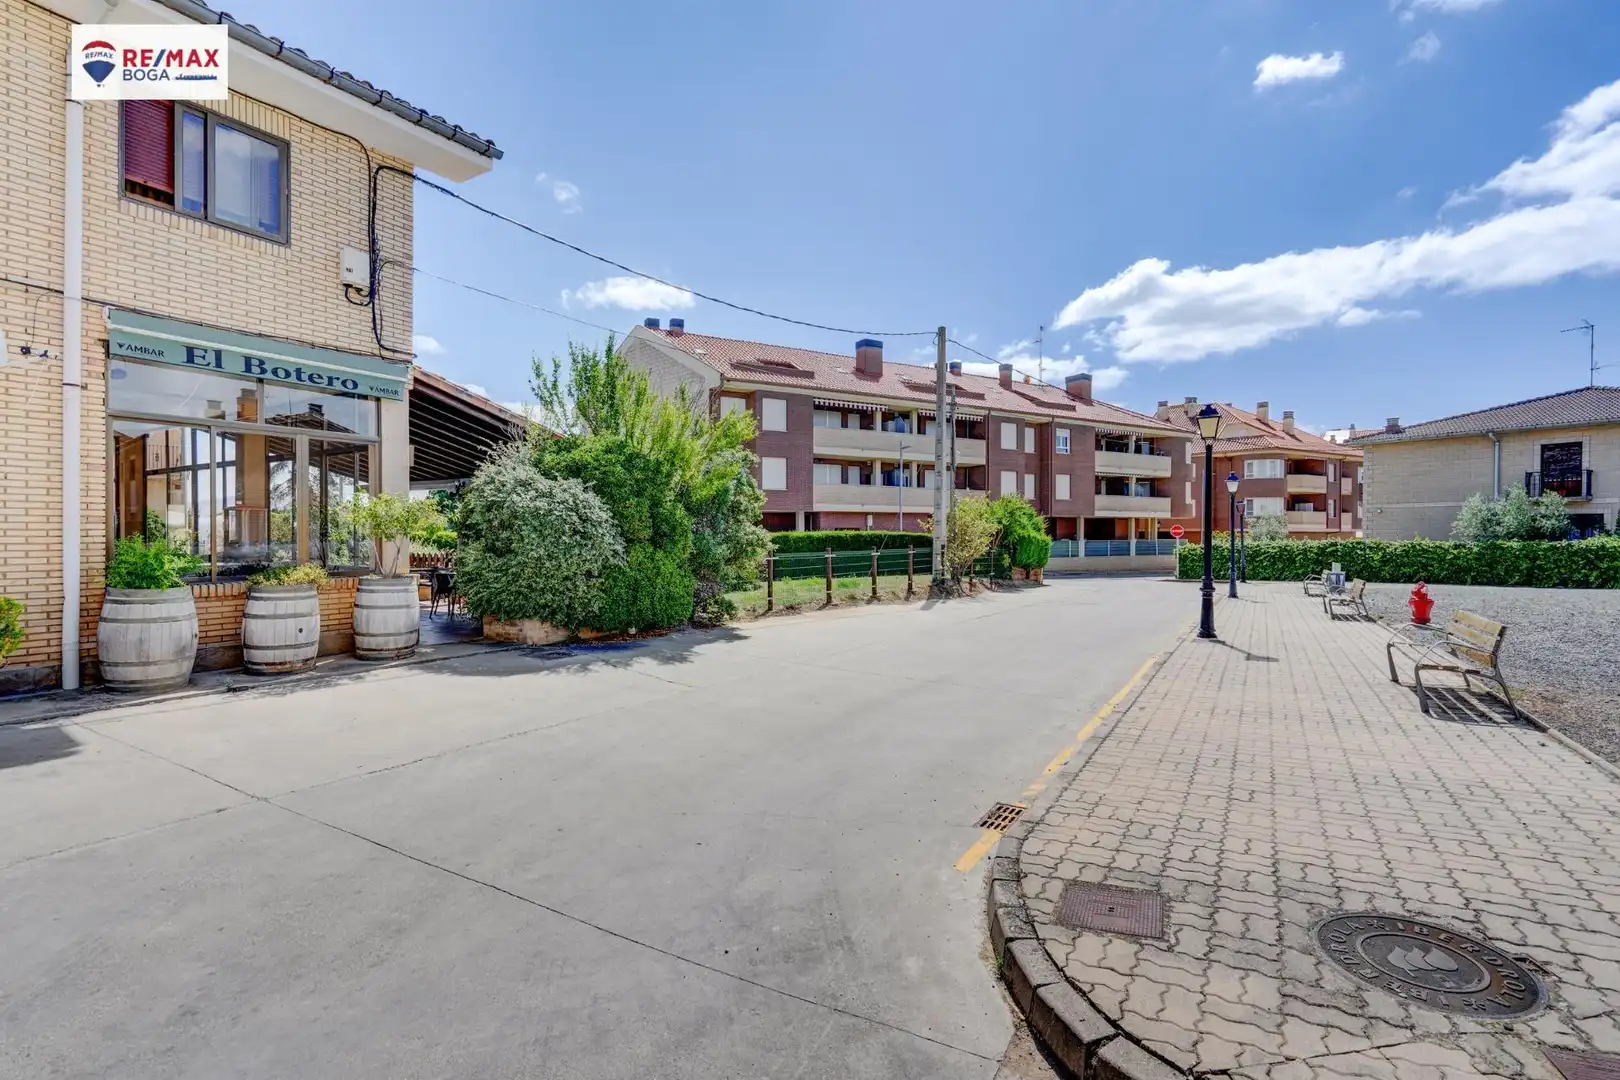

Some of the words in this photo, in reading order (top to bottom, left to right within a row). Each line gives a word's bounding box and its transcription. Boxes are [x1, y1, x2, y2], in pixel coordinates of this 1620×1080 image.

[126, 344, 165, 358] AMBAR
[182, 345, 225, 369] El
[242, 355, 359, 391] Botero
[374, 386, 400, 396] AMBAR
[1327, 920, 1450, 1007] IBERDROLA
[1397, 922, 1526, 1008] IBERDROLA
